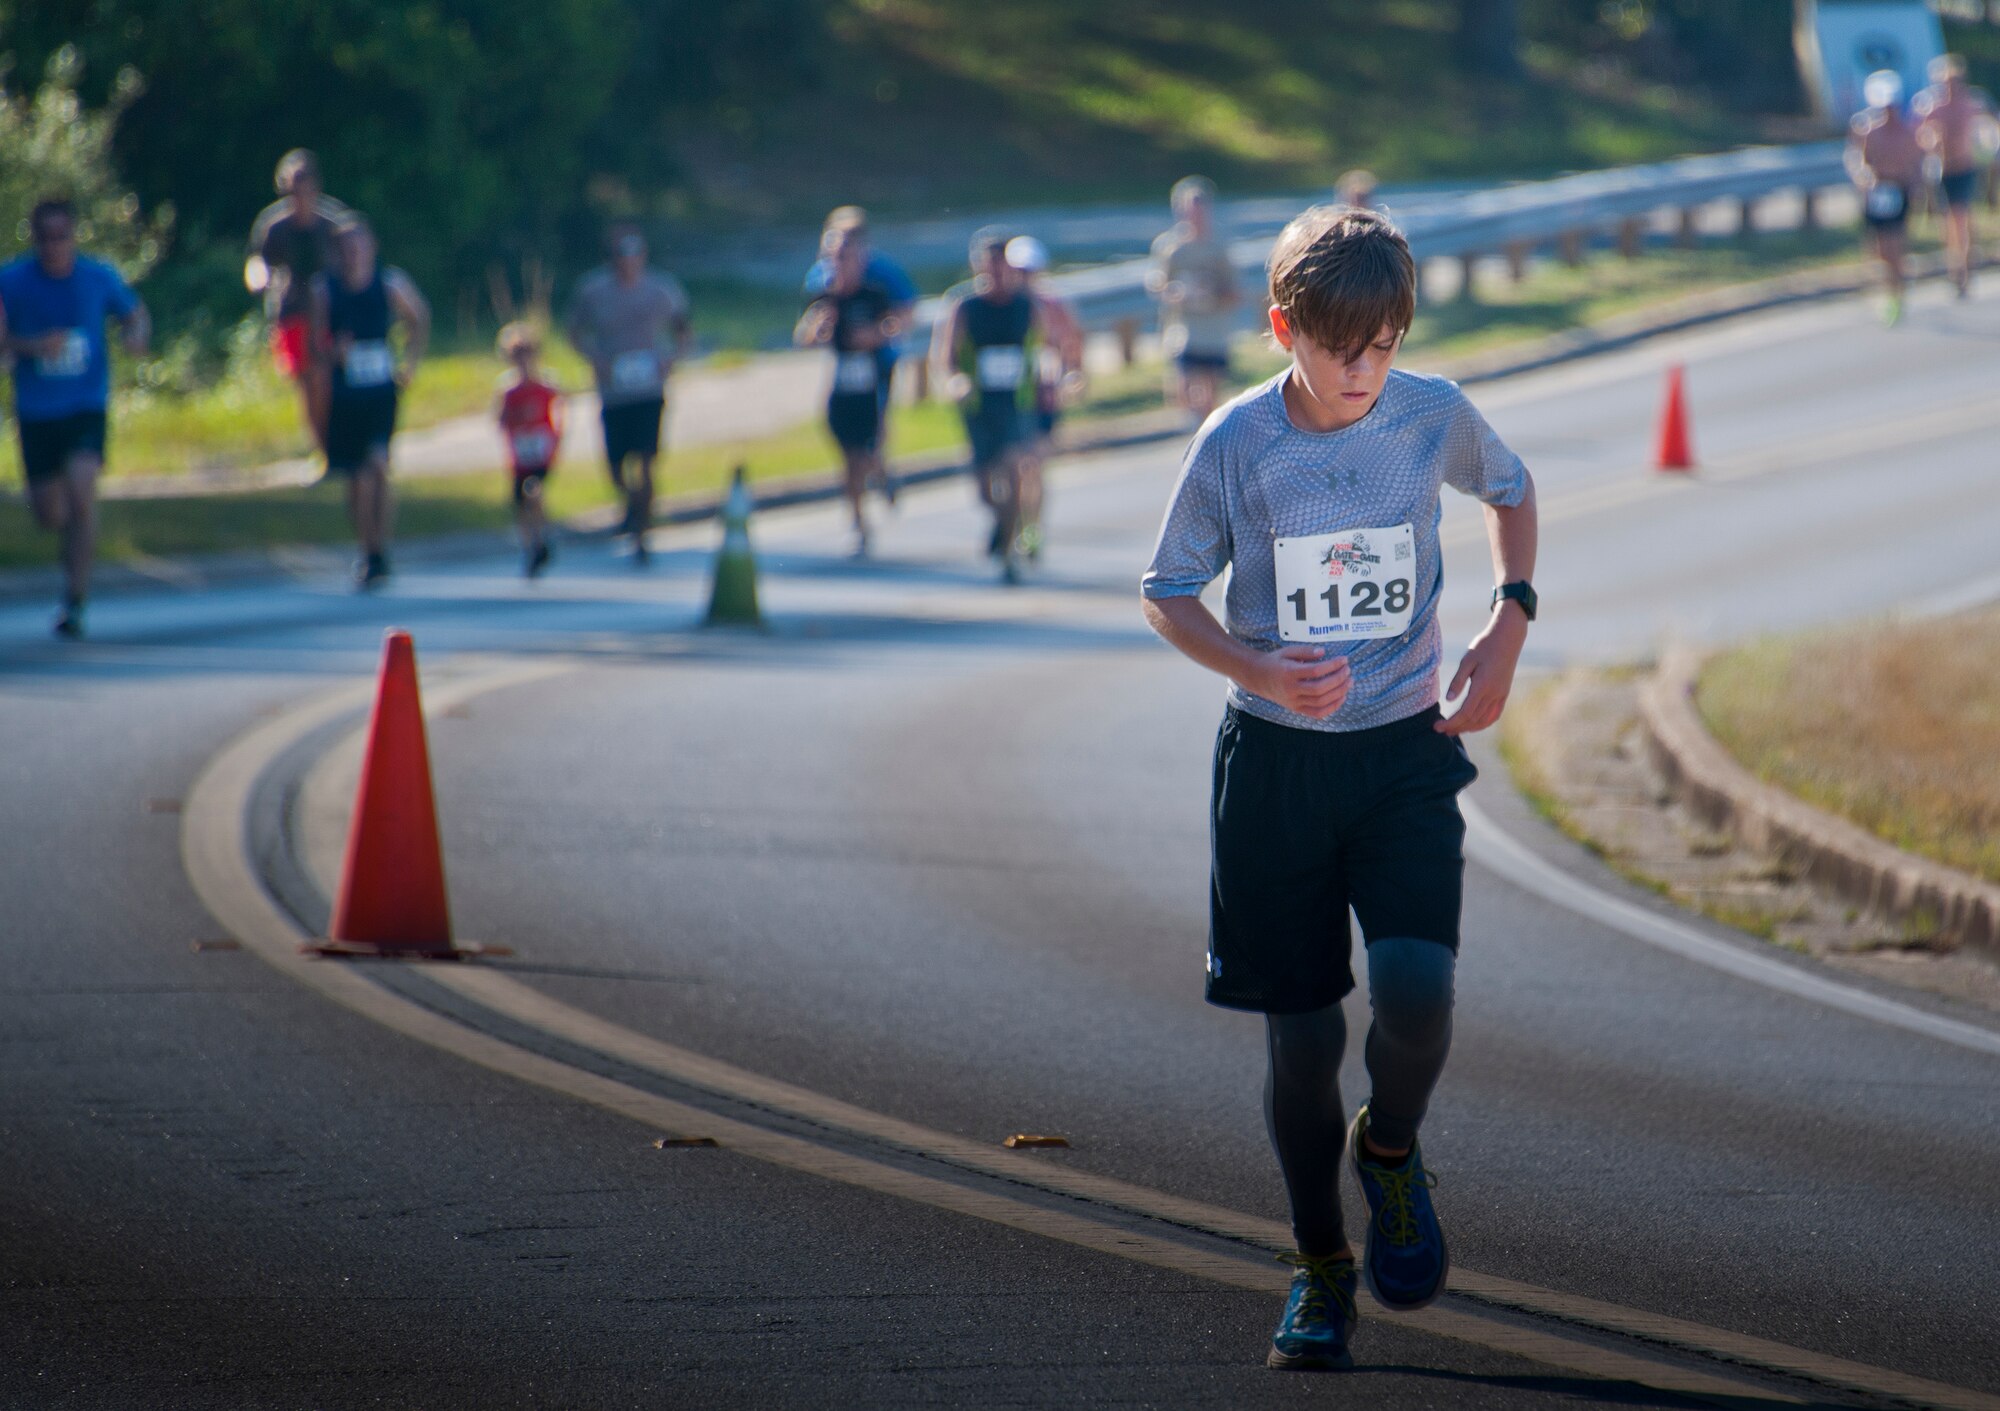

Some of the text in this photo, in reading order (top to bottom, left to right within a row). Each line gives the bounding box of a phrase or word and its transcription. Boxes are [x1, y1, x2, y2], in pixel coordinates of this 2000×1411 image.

[1334, 550, 1353, 560] GATE
[1360, 553, 1381, 563] GATE
[1287, 578, 1410, 621] 1128
[1309, 625, 1329, 636] Run
